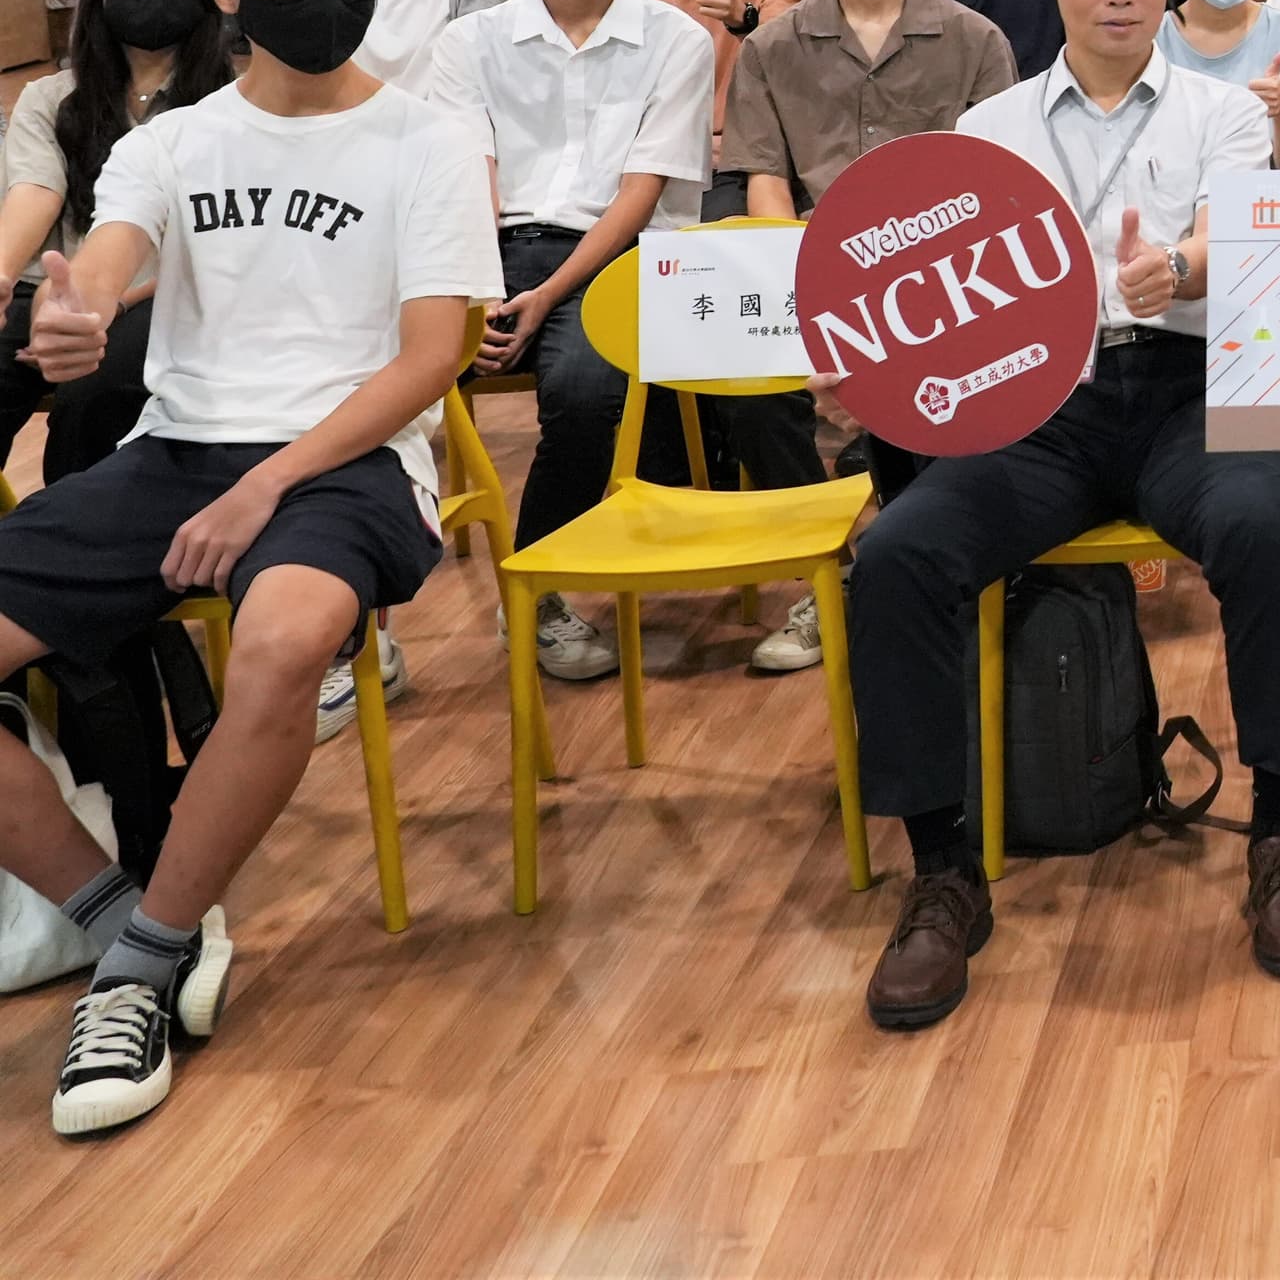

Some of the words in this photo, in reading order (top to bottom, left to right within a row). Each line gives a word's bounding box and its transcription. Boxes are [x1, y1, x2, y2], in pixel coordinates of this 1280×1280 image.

[189, 188, 272, 233] DAY
[284, 188, 365, 242] OFF
[845, 193, 978, 266] Welcome
[810, 207, 1072, 380] NCKU
[957, 347, 1045, 395] 國立成功大學
